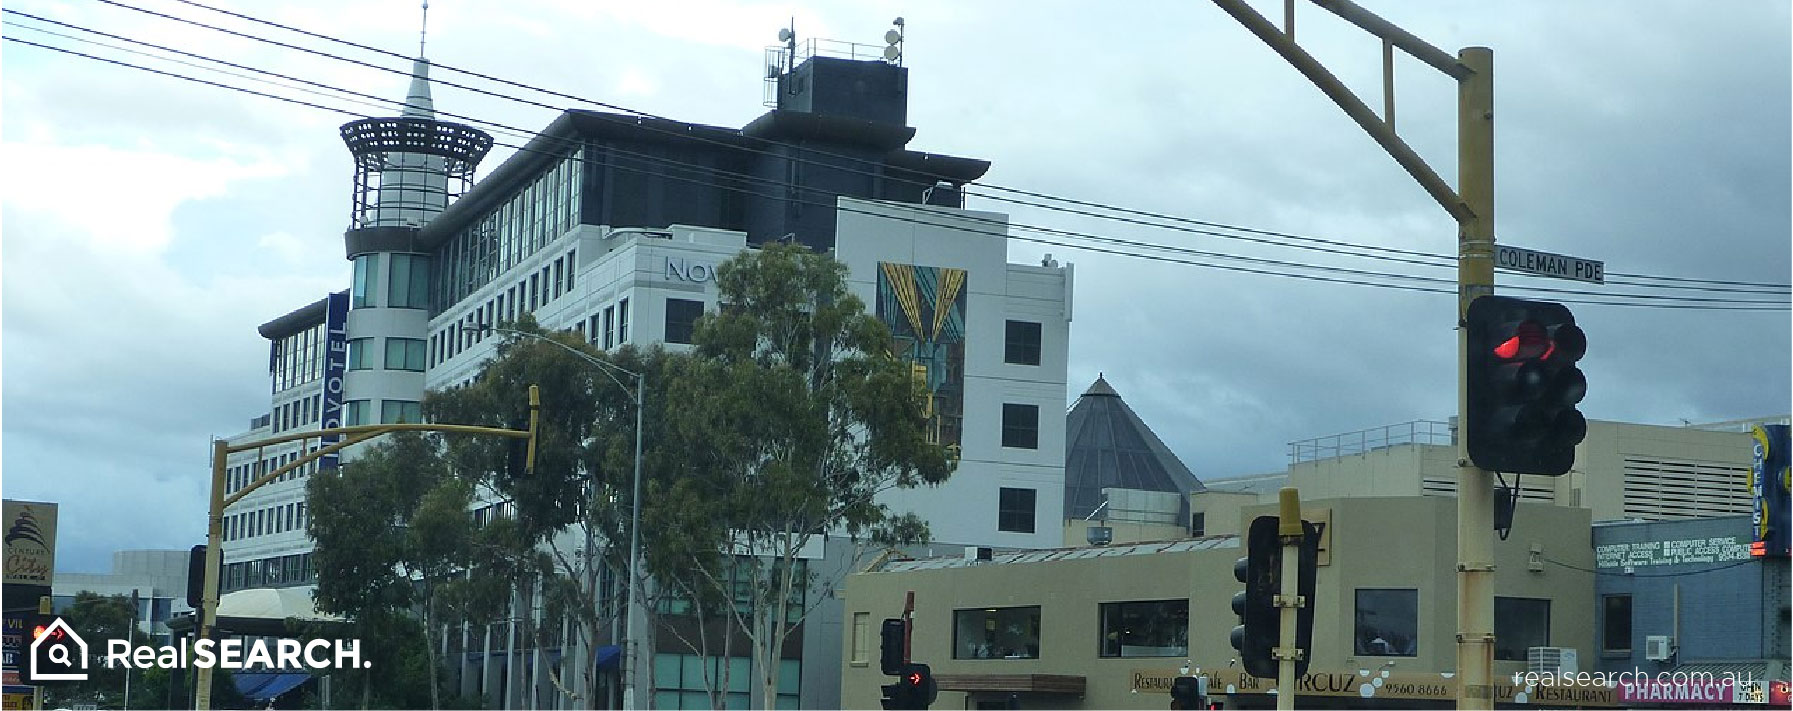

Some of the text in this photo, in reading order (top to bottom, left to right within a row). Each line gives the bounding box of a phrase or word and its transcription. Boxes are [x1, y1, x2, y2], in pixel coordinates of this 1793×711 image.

[1500, 248, 1602, 280] COLEMAN PDE
[1135, 673, 1174, 690] RESTAURA
[1536, 682, 1612, 703] RESTAURANT
[1624, 683, 1726, 700] PHARMACY
